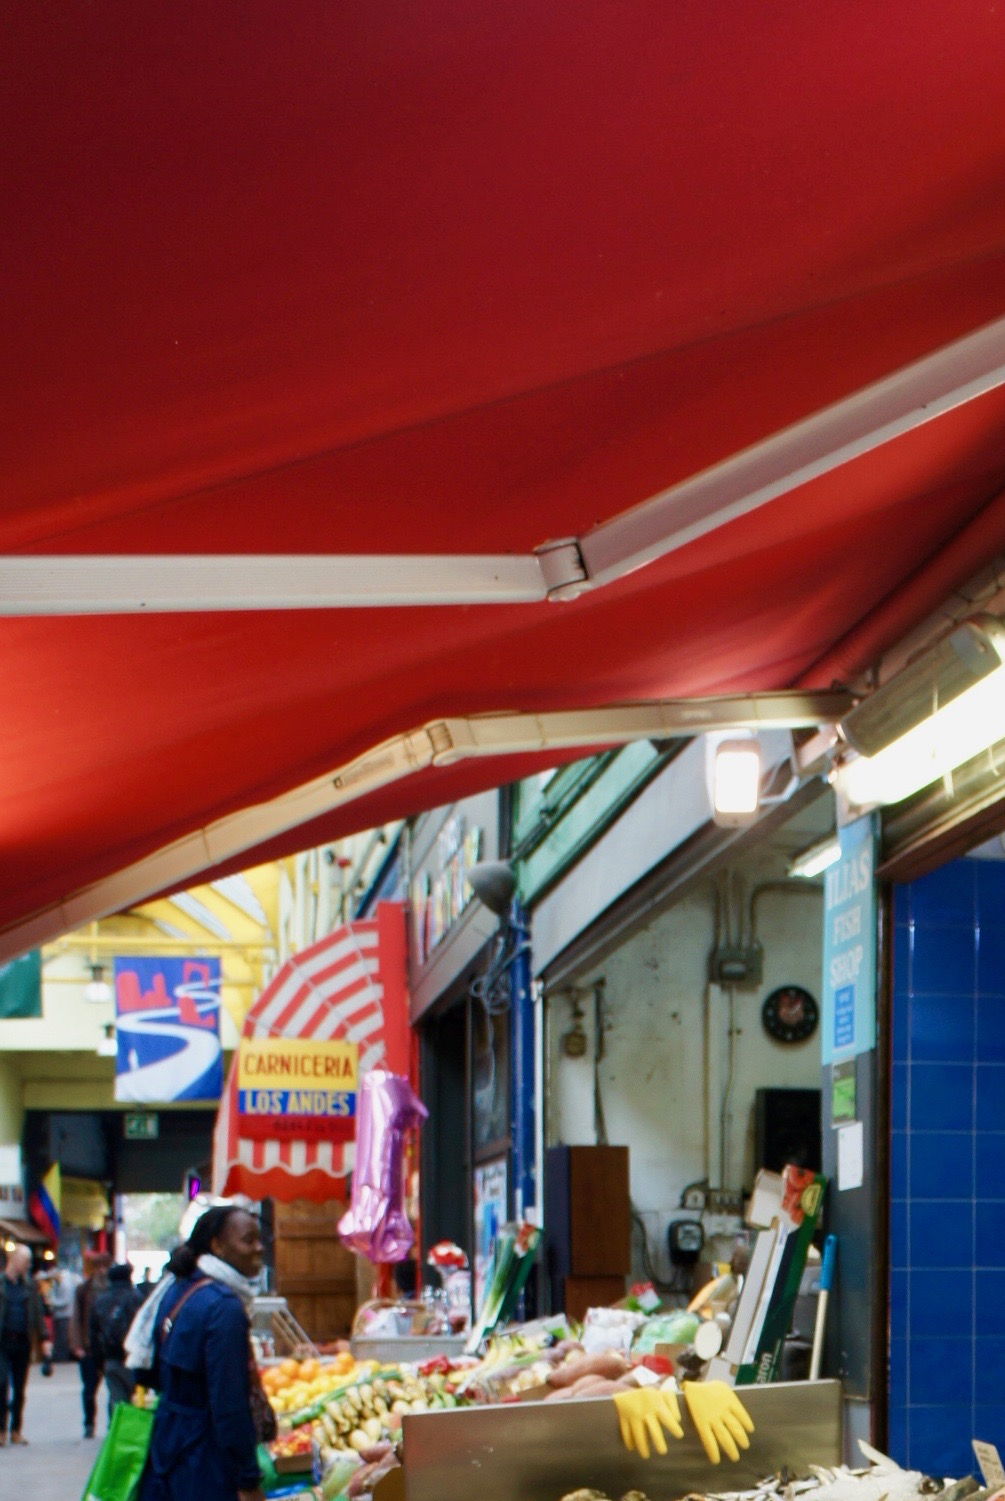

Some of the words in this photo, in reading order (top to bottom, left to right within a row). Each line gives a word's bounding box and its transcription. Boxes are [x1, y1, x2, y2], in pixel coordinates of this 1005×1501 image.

[827, 848, 869, 910] ILIAS
[833, 904, 861, 945] FISH
[830, 944, 863, 988] SHOP
[245, 1053, 353, 1077] CARNICERIA
[246, 1090, 282, 1113] LOS
[288, 1091, 350, 1115] ANDES
